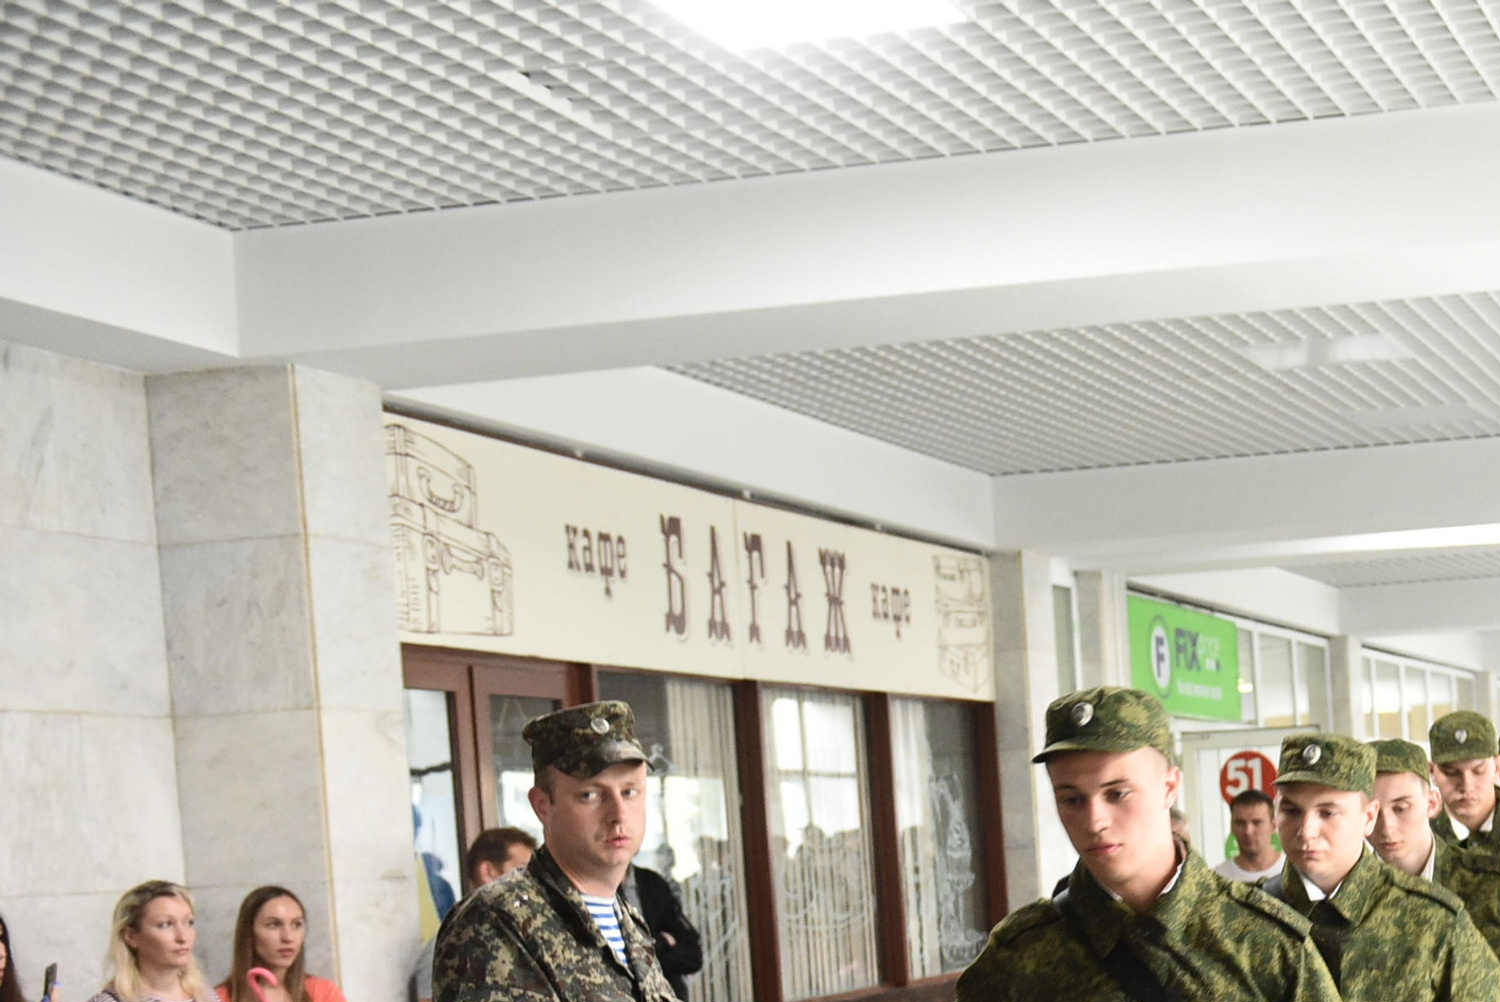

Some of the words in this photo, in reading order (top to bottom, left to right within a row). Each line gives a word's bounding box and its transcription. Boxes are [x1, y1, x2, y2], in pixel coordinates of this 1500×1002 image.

[564, 523, 627, 597] кафе
[660, 513, 851, 653] БАГАЖ
[871, 582, 911, 639] кафе
[1226, 758, 1263, 796] 51
